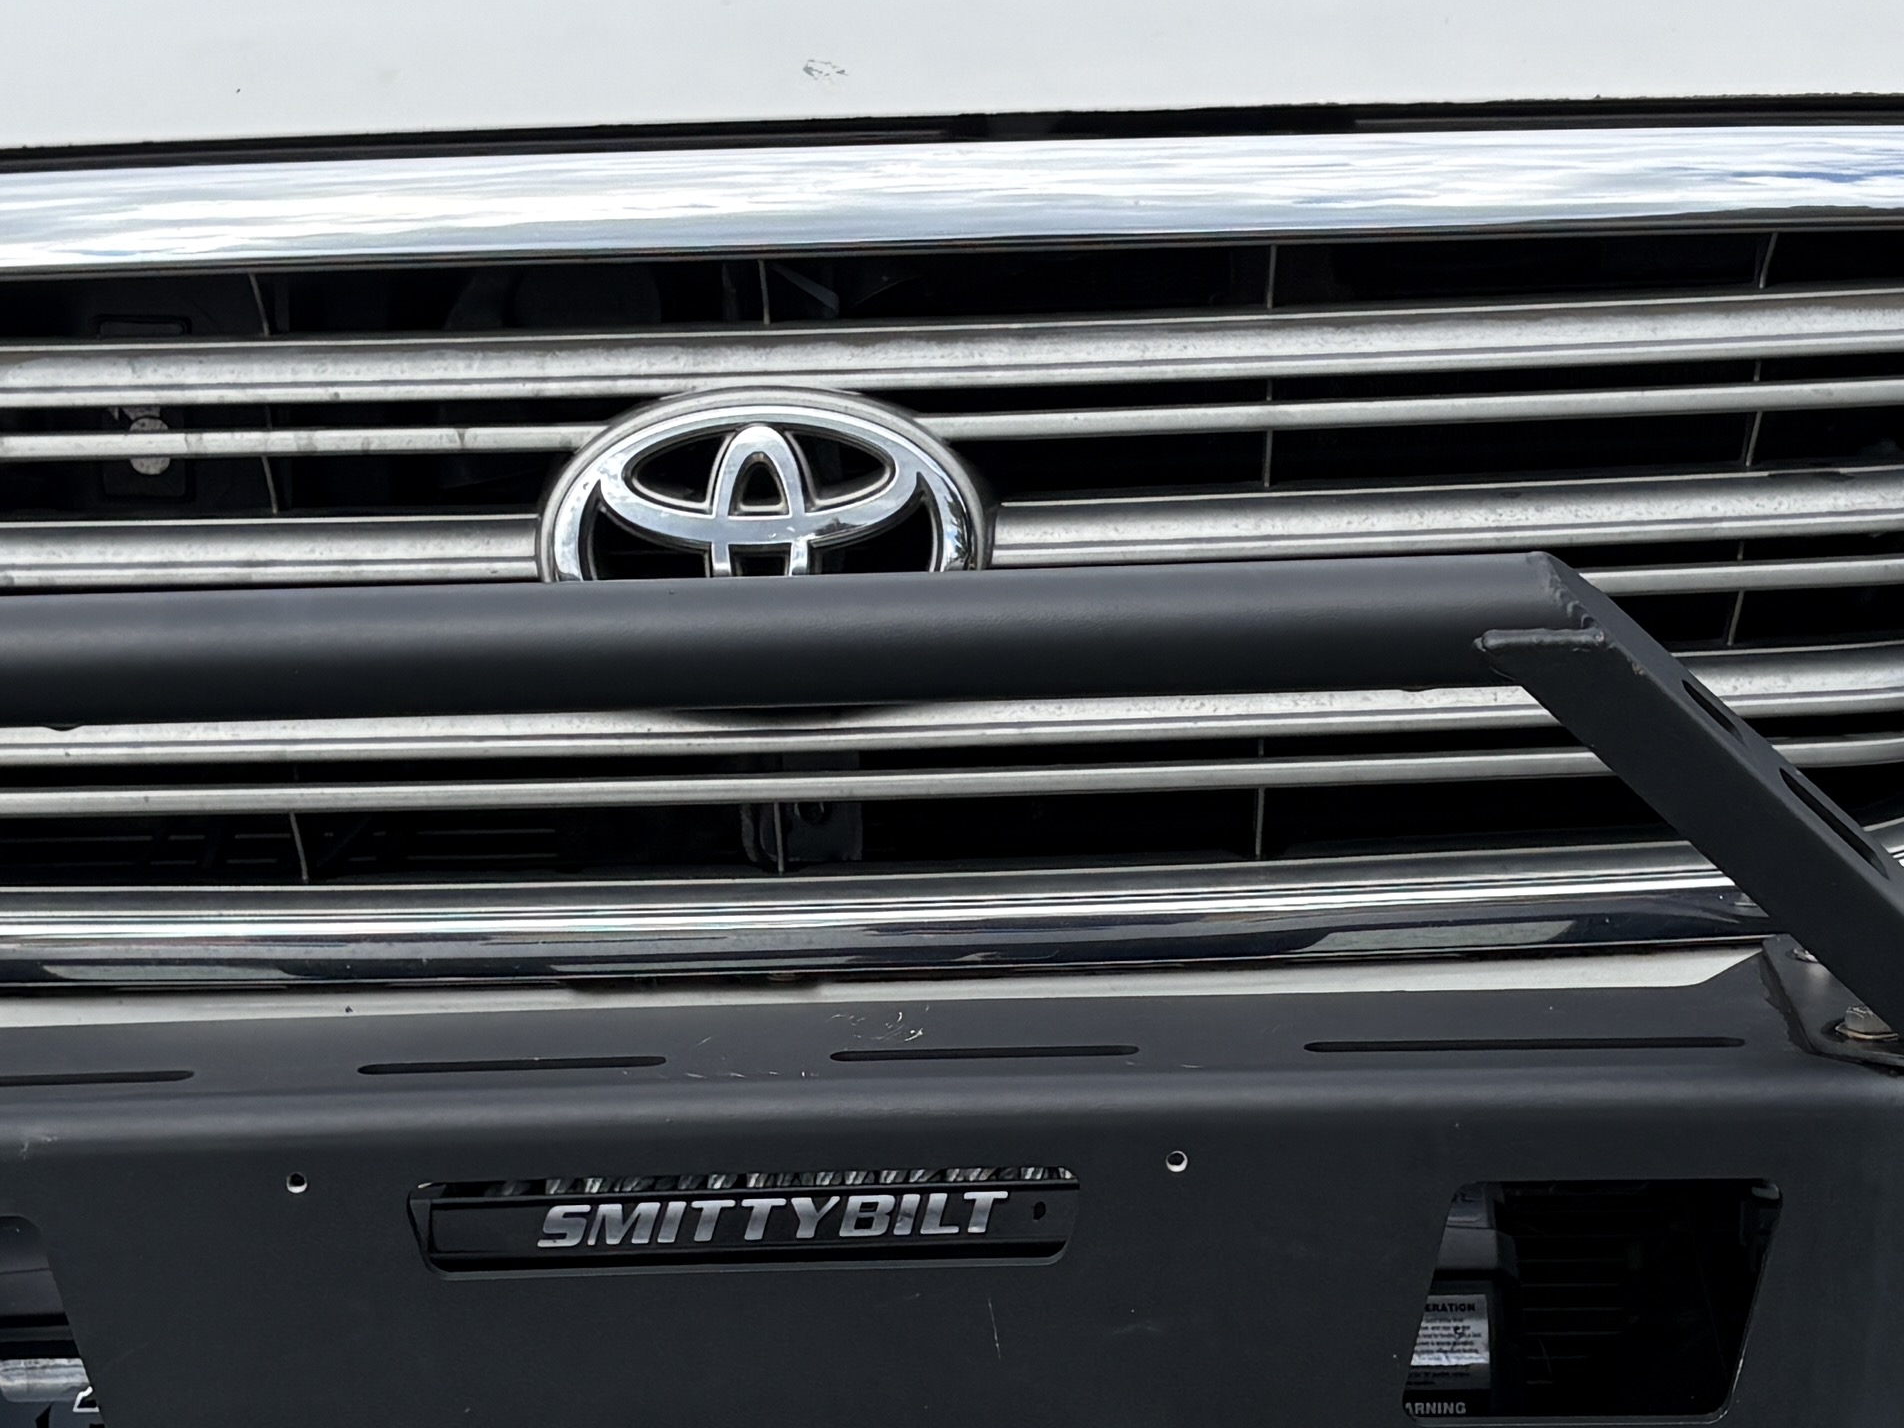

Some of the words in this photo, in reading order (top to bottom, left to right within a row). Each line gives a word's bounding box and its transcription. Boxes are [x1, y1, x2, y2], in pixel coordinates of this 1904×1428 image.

[536, 1190, 1010, 1249] SMITTYBILT
[1424, 1303, 1476, 1313] ERATION
[1404, 1401, 1467, 1415] ARNING
